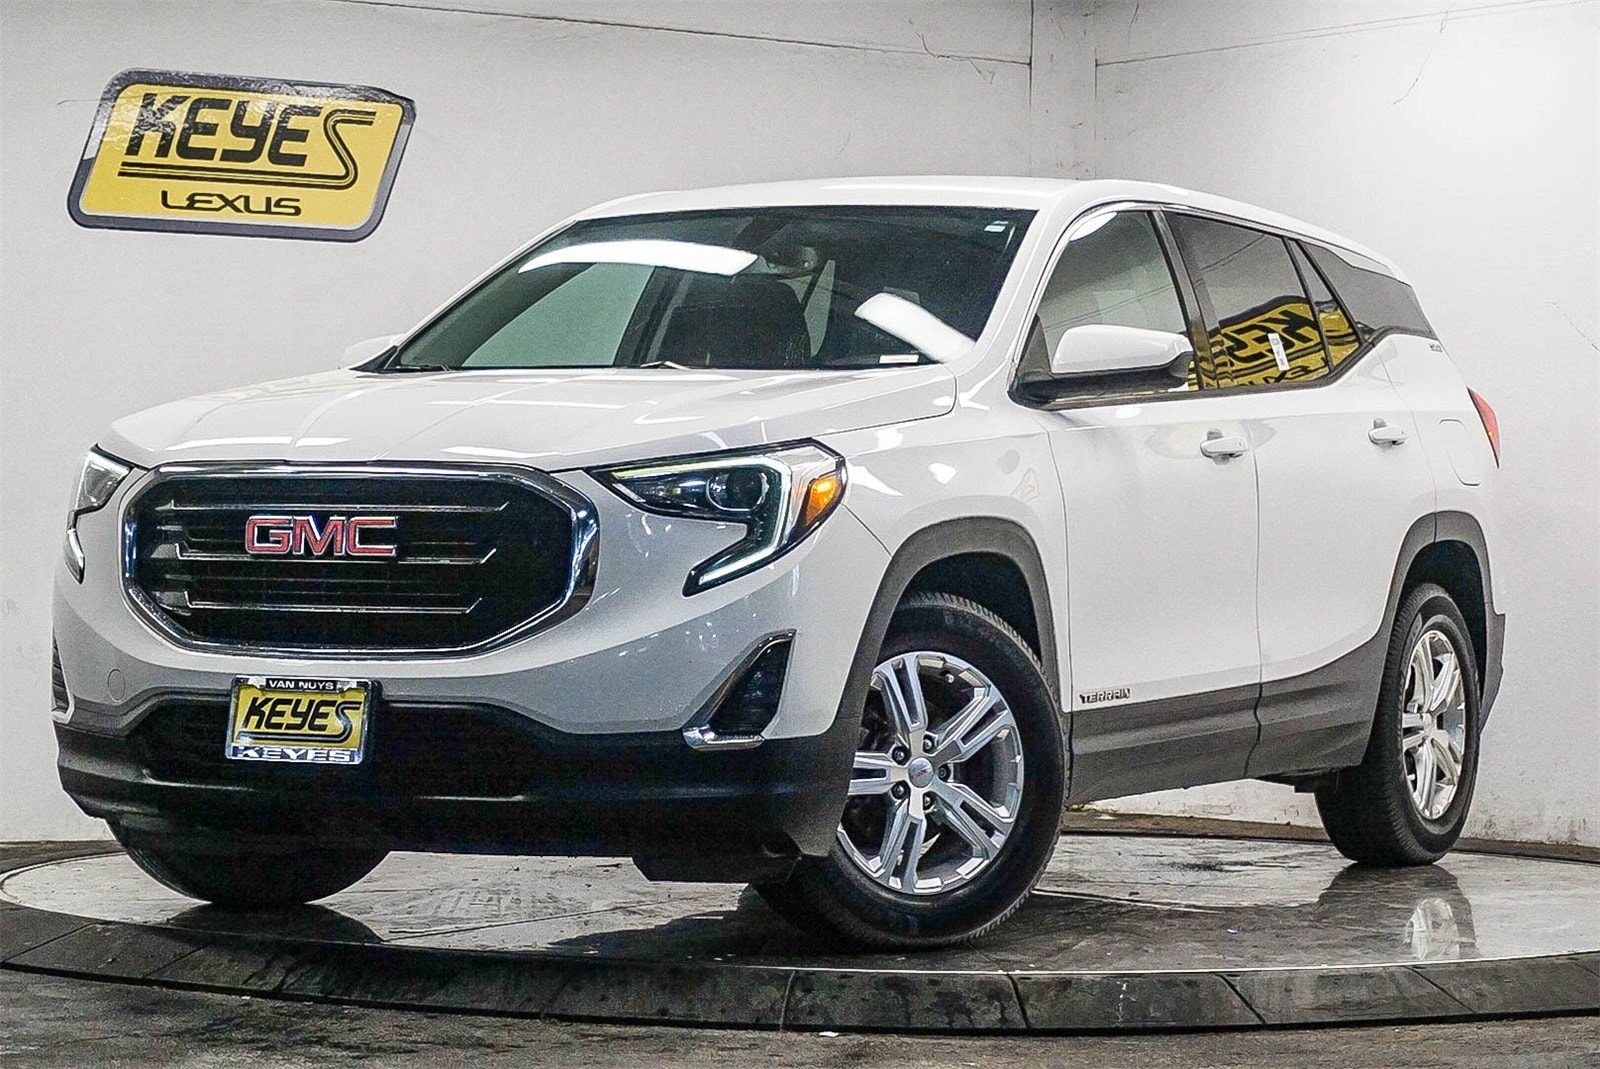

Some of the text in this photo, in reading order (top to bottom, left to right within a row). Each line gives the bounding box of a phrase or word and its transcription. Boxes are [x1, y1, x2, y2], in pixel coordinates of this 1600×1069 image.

[121, 93, 376, 188] KEYES
[161, 190, 301, 217] LEXUS
[245, 515, 398, 556] GMC
[269, 679, 335, 690] VAN NUYS
[1079, 688, 1131, 704] TERRAIN
[240, 697, 362, 742] KEYES
[237, 747, 351, 762] KEYES
